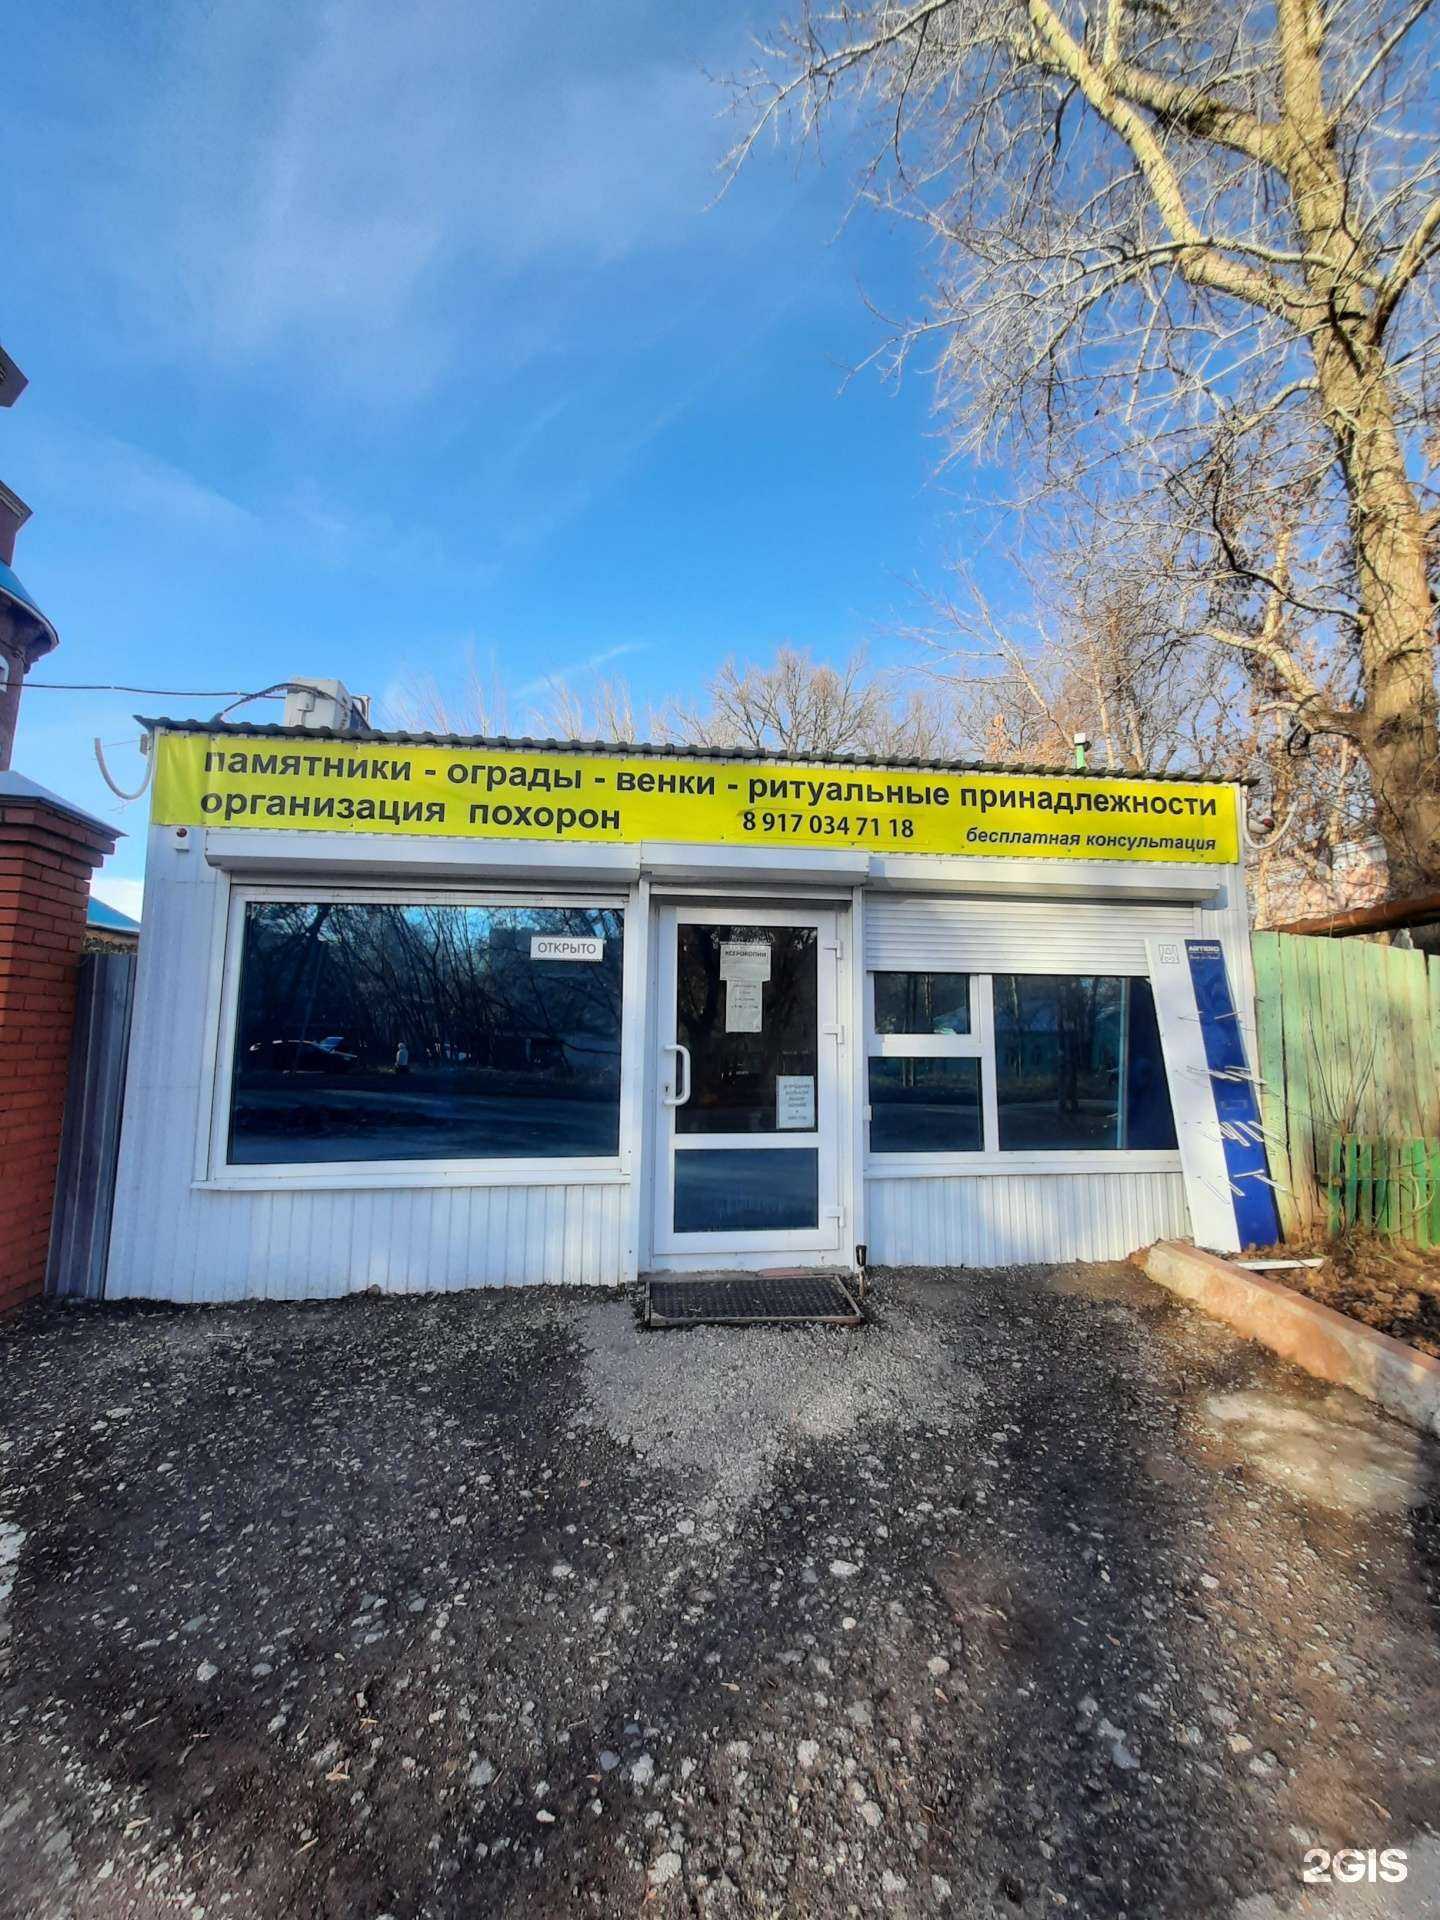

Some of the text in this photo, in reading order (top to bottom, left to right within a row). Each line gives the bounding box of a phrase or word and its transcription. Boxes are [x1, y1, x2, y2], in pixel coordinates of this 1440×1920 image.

[204, 751, 411, 781] памятники
[447, 763, 582, 793] ограды
[616, 772, 715, 796] венки
[748, 778, 950, 807] ритуальные
[960, 788, 1217, 816] принадлежности
[200, 792, 620, 834] организация похорон
[742, 811, 914, 838] 8 917 034 71 18
[966, 826, 1216, 853] бесплатная консультация
[536, 942, 597, 954] ОТКРЫТО
